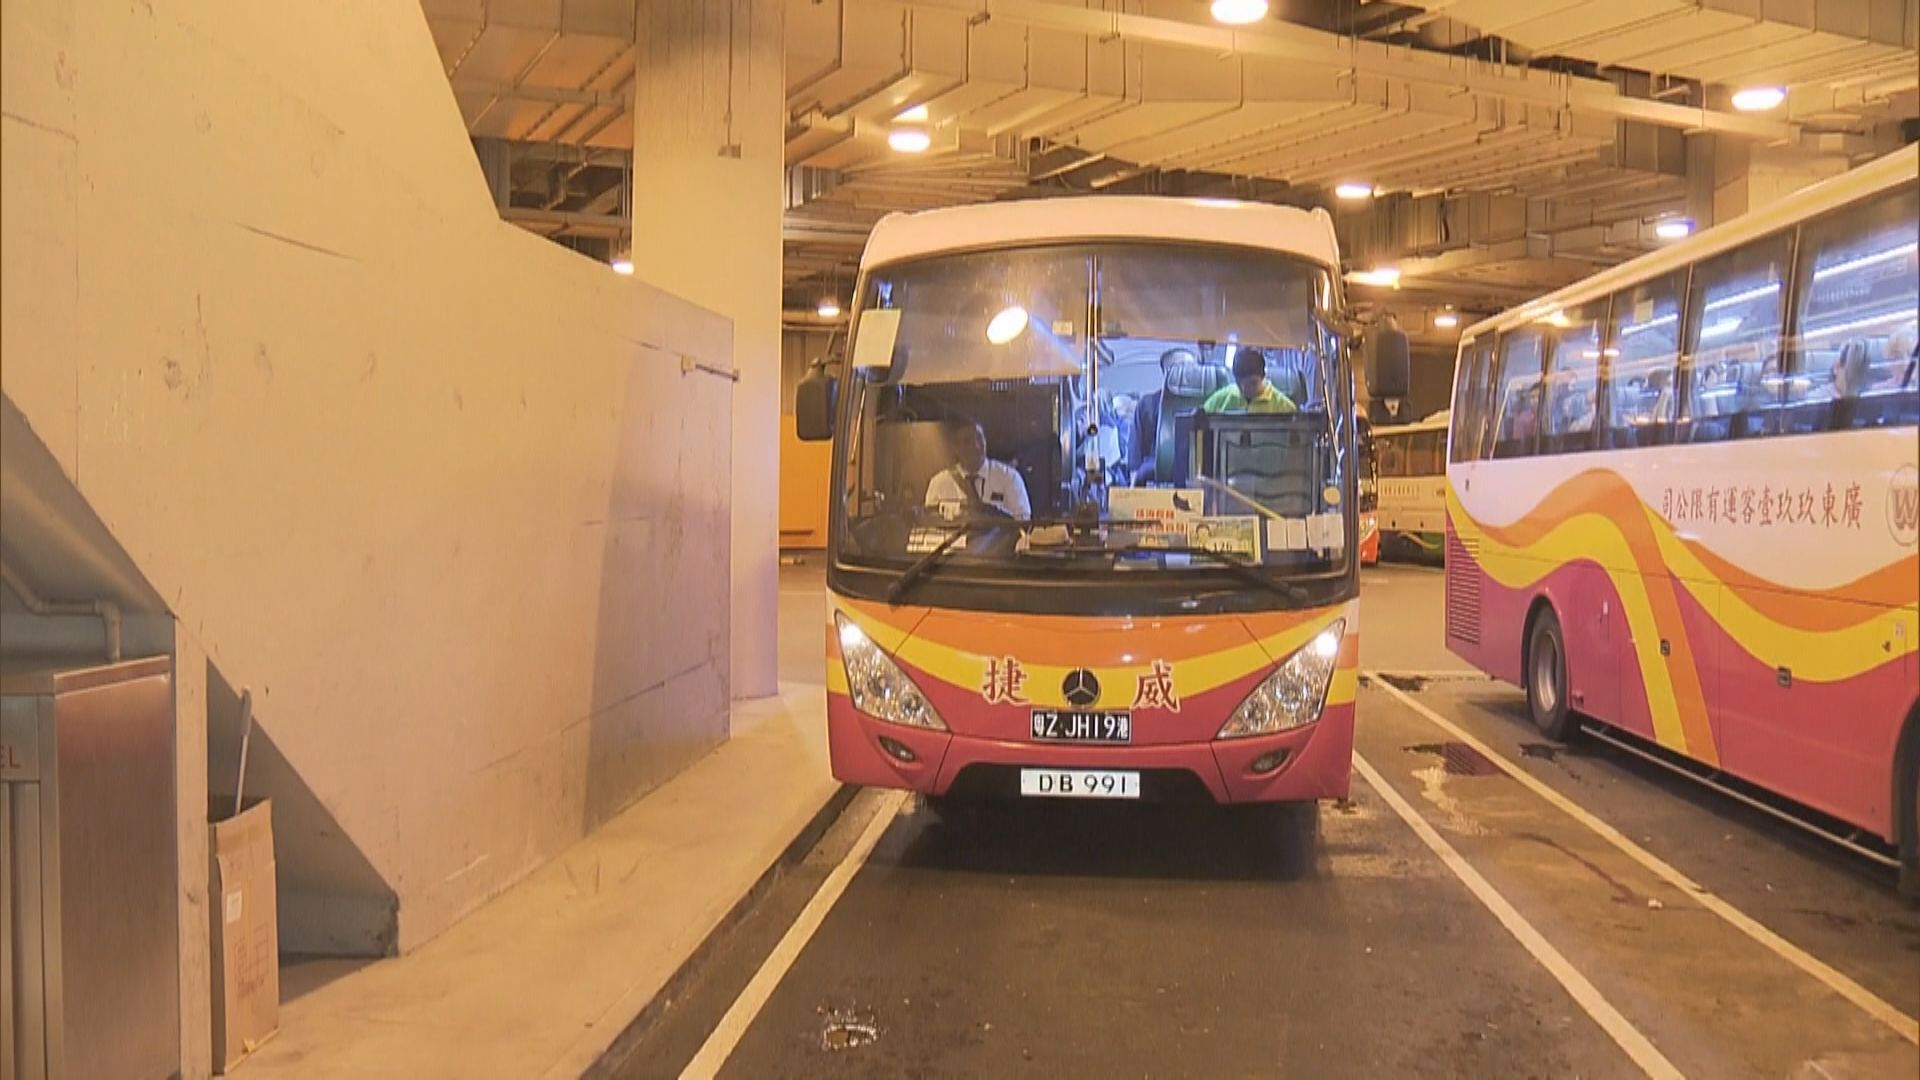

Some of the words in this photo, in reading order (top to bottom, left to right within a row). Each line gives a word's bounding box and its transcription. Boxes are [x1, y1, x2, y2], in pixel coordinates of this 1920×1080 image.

[983, 657, 1029, 704] 捷
[1131, 660, 1180, 712] 威
[1039, 774, 1073, 792] DB
[1084, 774, 1126, 795] 991
